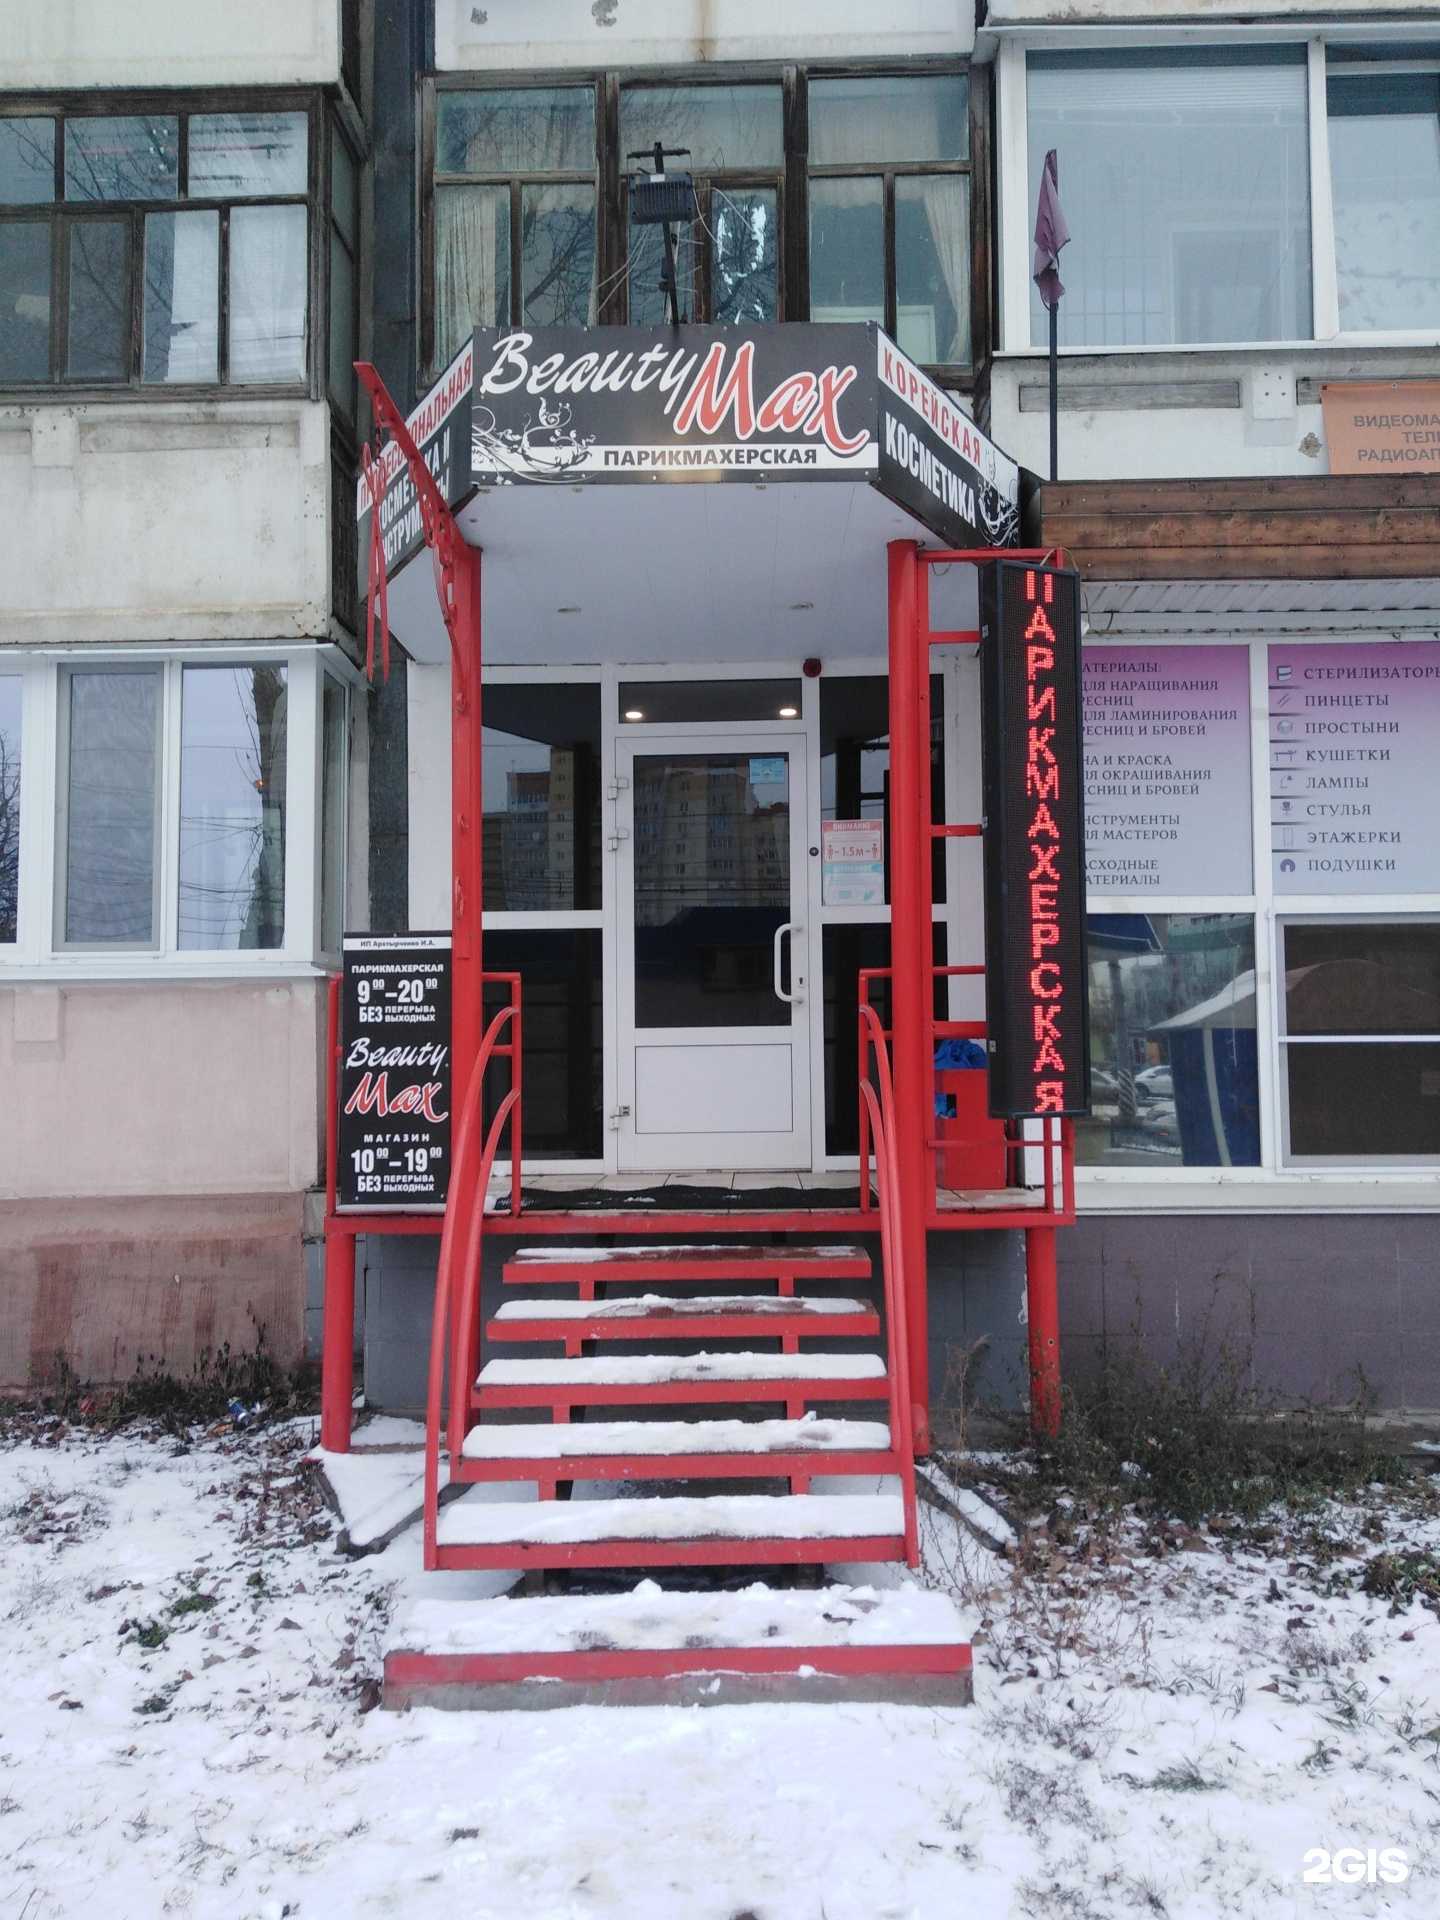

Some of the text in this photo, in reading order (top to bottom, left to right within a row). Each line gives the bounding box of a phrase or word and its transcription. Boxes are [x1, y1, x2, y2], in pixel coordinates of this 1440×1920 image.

[480, 332, 870, 457] Beauty Max
[883, 348, 981, 464] КОРЕЙСКАЯ
[1401, 431, 1440, 443] ТЕЛ
[444, 426, 450, 464] И
[604, 448, 817, 466] ПАРИКМАХЕРСКАЯ
[886, 411, 977, 528] КОСМЕТИКА
[1110, 680, 1218, 691] НАРАЩИВАНИЯ
[1305, 694, 1389, 707] ПИНЦЕТЫ
[1110, 710, 1237, 721] ЛАМИНИРОВАНИЯ
[1138, 726, 1148, 735] И
[1152, 723, 1206, 736] БРОВЕЙ
[1305, 722, 1400, 734] ПРОСТЫНИ
[1103, 755, 1112, 765] И
[1117, 755, 1172, 765] КРАСКА
[1306, 749, 1391, 761] КУШЕТКИ
[1102, 770, 1211, 780] ОКРАШИВАНИЯ
[1305, 777, 1369, 788] ЛАМПЫ
[1085, 783, 1200, 796] СНИЦ И БРОВЕЙ
[1306, 804, 1371, 816] СТУЛЬЯ
[1084, 815, 1180, 825] НСТРУМЕНТЫ
[1025, 569, 1065, 1112] ПАРИКМАХЕРСКАЯ
[1103, 829, 1178, 840] МАСТЕРОВ
[1307, 831, 1401, 843] ЭТАЖЕРКИ
[1085, 859, 1159, 872] СХОДНЫЕ
[1308, 859, 1396, 872] ПОДУШКИ
[1086, 874, 1160, 885] АТЕРИАЛЫ
[351, 963, 444, 974] ПАРИКМАХЕРСКАЯ
[359, 1005, 436, 1023] БЕЗ ПЕРЕРЫВА
[385, 1014, 436, 1024] ВЫХОДНЫХ
[346, 1037, 447, 1076] Beauty
[344, 1071, 448, 1122] Max
[363, 1133, 430, 1143] МАГАЗИН
[357, 1174, 435, 1192] БЕЗ ПЕРЕРЫВА
[383, 1183, 435, 1193] ВЫХОДНЫХ
